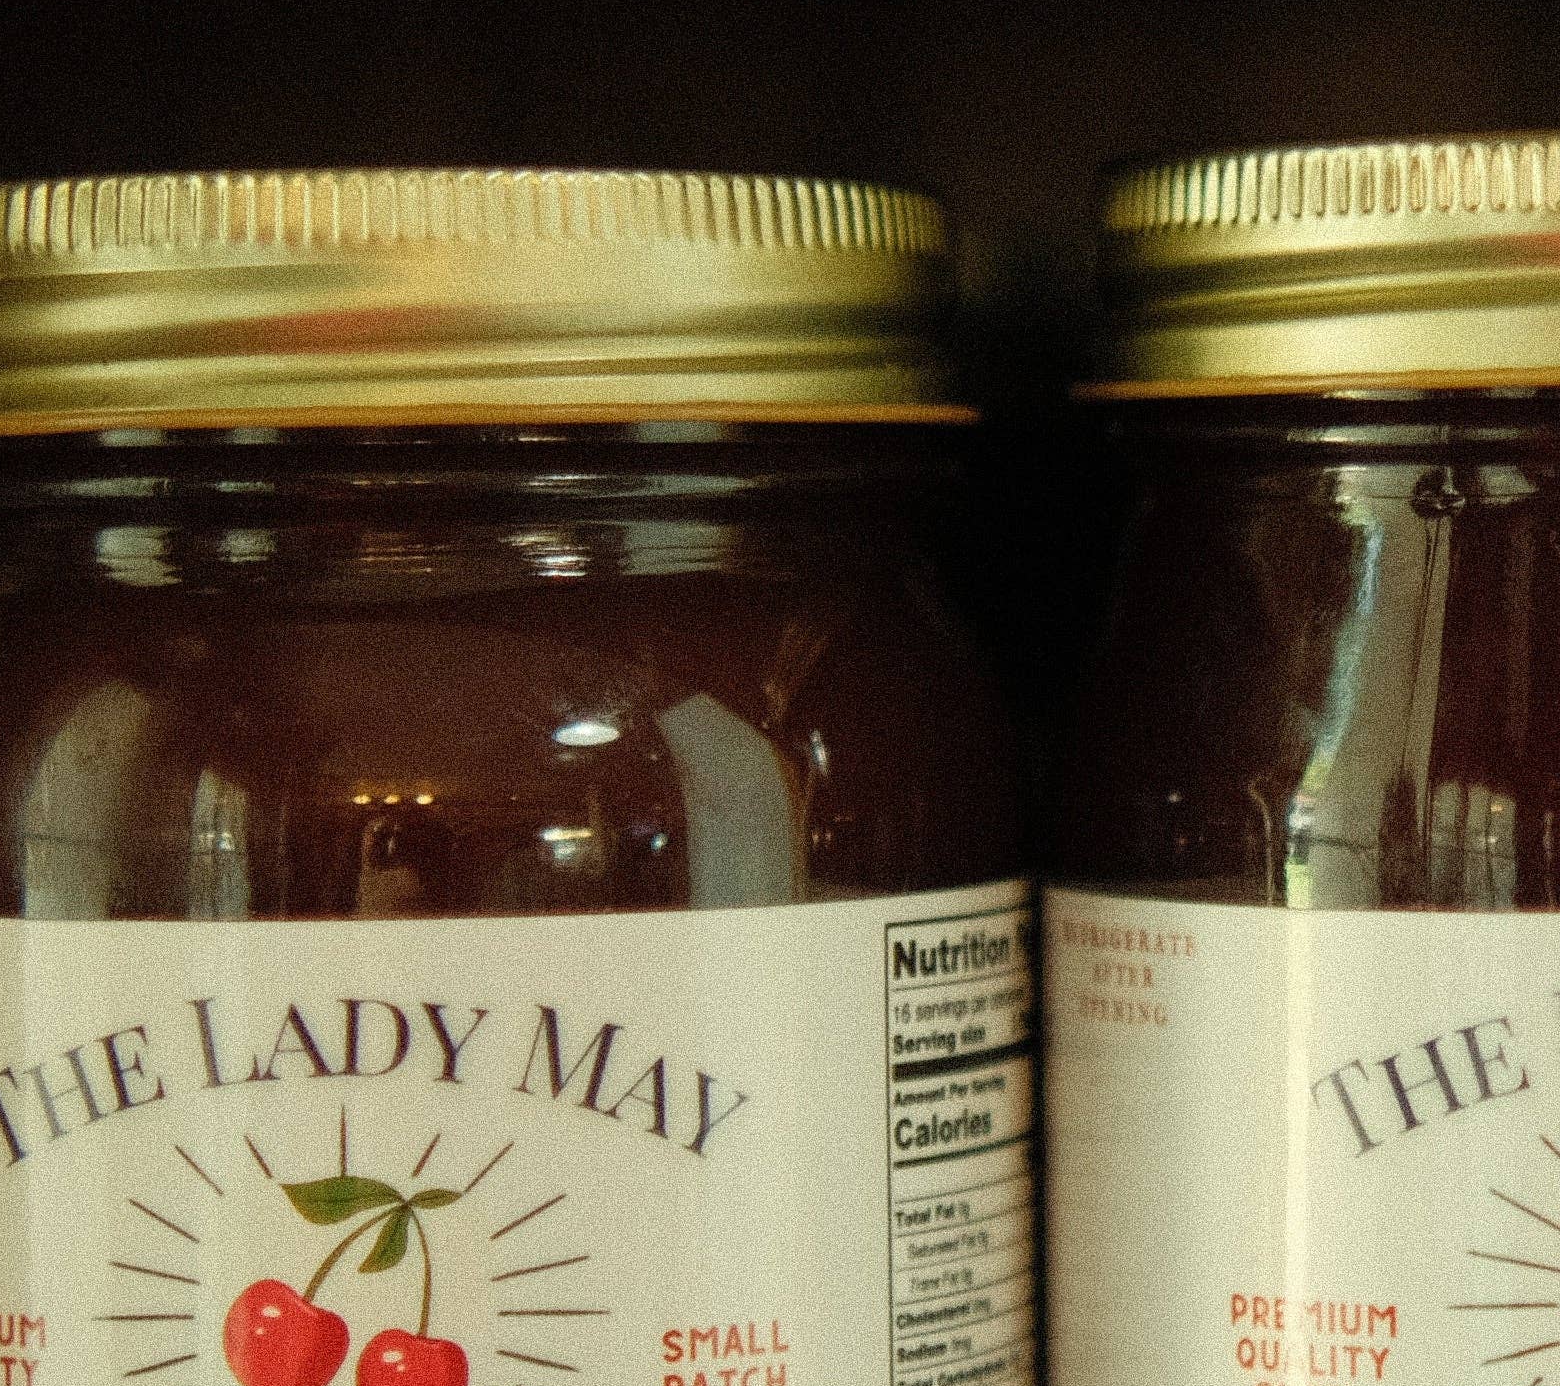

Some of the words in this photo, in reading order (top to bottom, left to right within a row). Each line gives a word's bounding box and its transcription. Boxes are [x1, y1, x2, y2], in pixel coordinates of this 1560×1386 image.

[893, 932, 1010, 980] Nutrition
[893, 1032, 956, 1056] Serving
[188, 999, 488, 1088] LADY
[515, 1007, 750, 1160] MAY
[1311, 1017, 1530, 1160] THE
[895, 1109, 992, 1150] Calories
[1228, 1292, 1400, 1340] PREMIUM
[661, 1321, 793, 1364] SMALL
